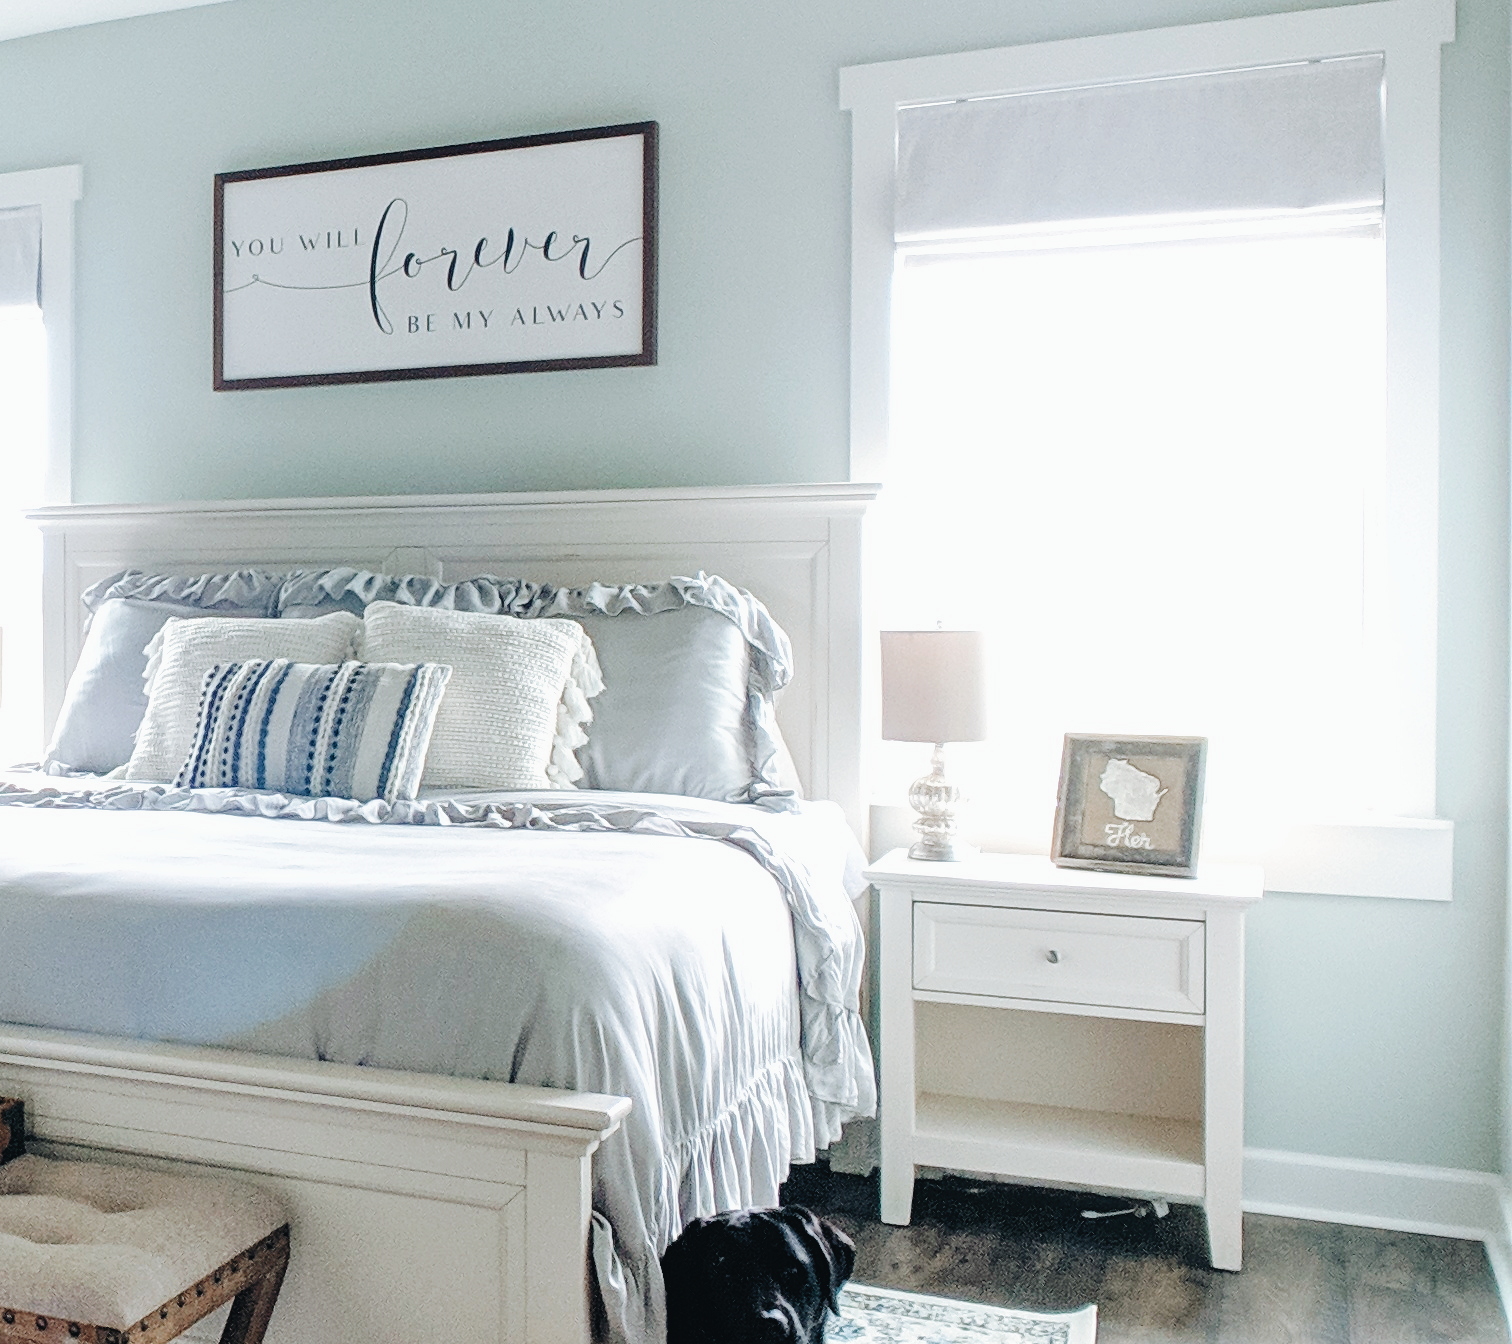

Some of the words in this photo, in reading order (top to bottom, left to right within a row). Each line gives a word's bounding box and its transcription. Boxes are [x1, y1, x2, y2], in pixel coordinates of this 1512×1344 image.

[231, 236, 284, 258] YOU
[298, 227, 365, 251] WILL
[370, 198, 633, 335] forever
[407, 313, 437, 334] BE
[453, 308, 494, 330] MY
[511, 299, 625, 326] ALWAYS
[1105, 821, 1154, 850] Her
